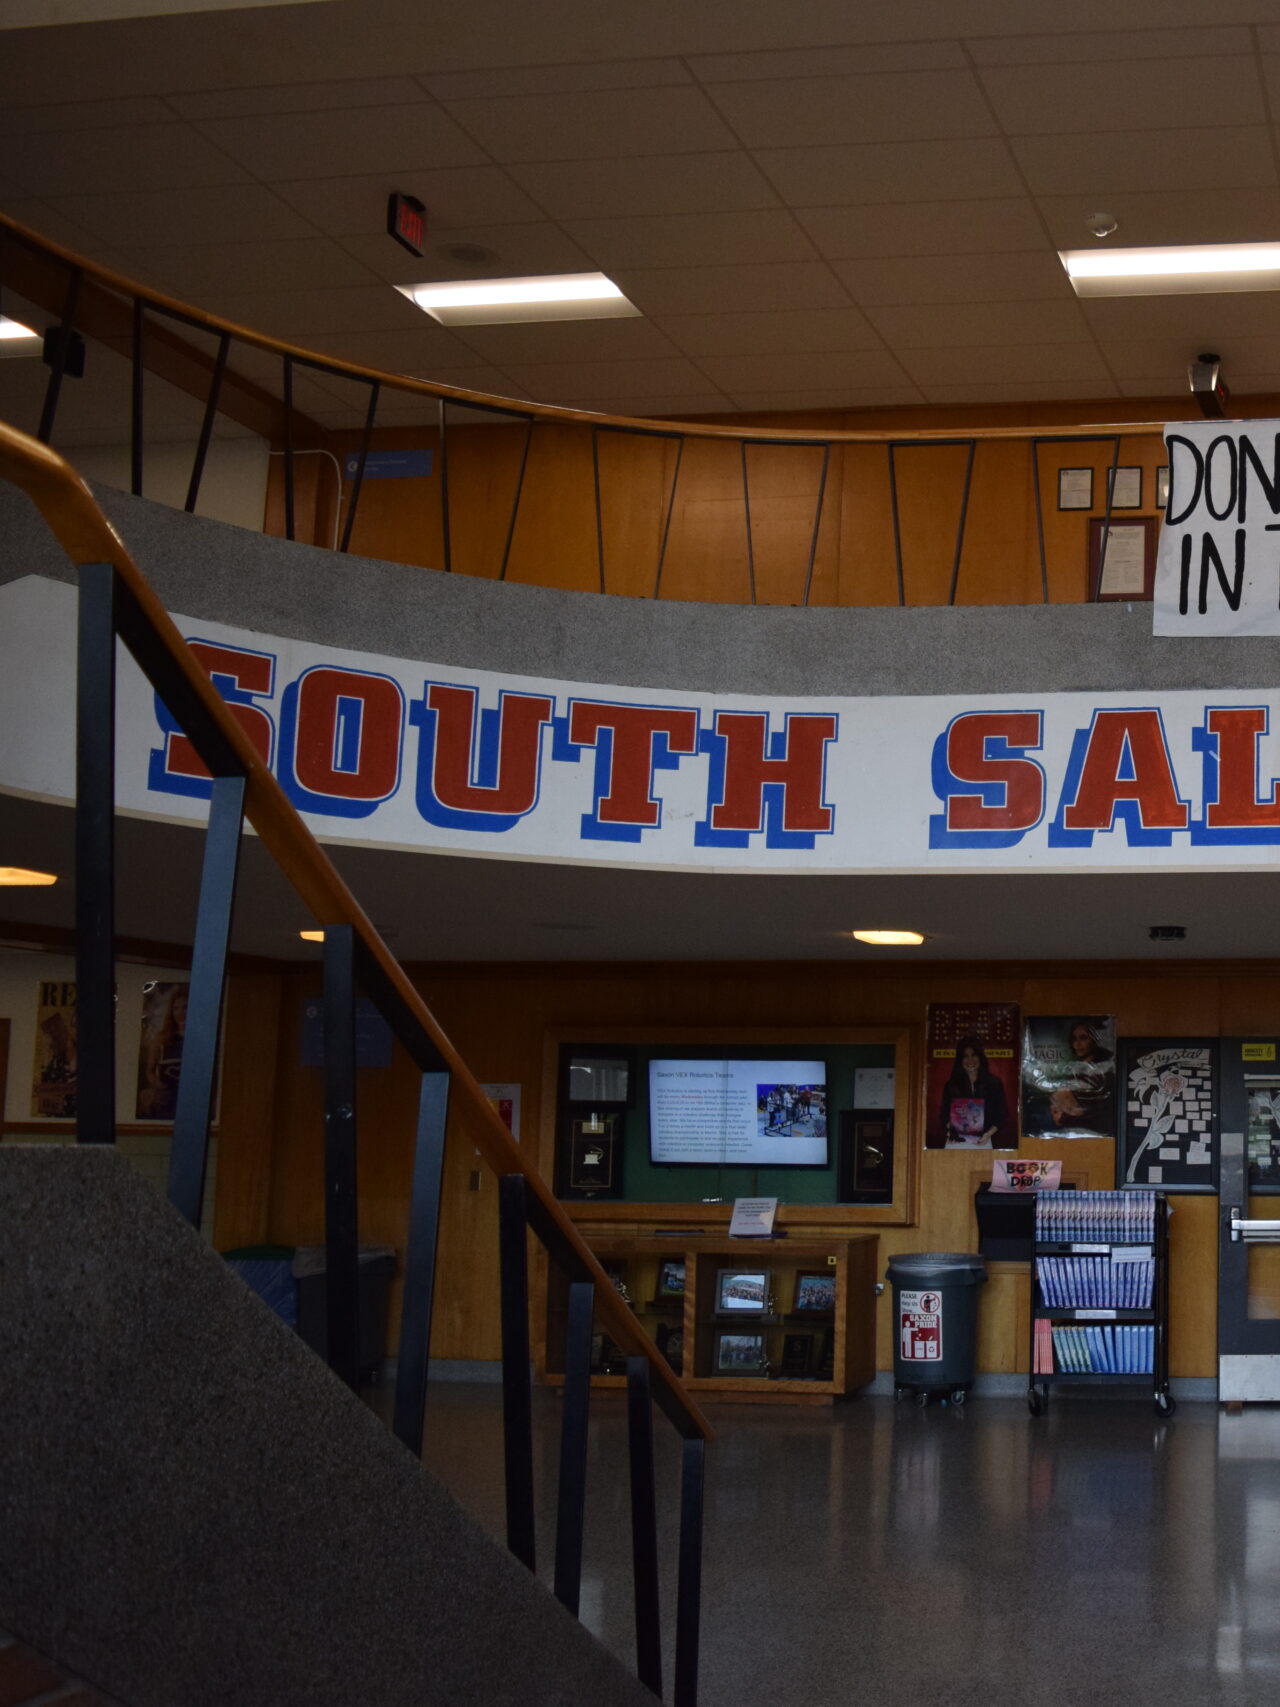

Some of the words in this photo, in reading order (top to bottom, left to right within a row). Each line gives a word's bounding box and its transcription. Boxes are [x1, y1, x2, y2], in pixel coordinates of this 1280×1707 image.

[400, 203, 431, 249] EXIT
[1180, 529, 1246, 615] IN
[148, 636, 839, 850] SOUTH
[41, 983, 78, 1006] RE
[934, 1009, 1012, 1041] READ
[1006, 1162, 1048, 1175] BOOK
[1011, 1176, 1041, 1187] DROP
